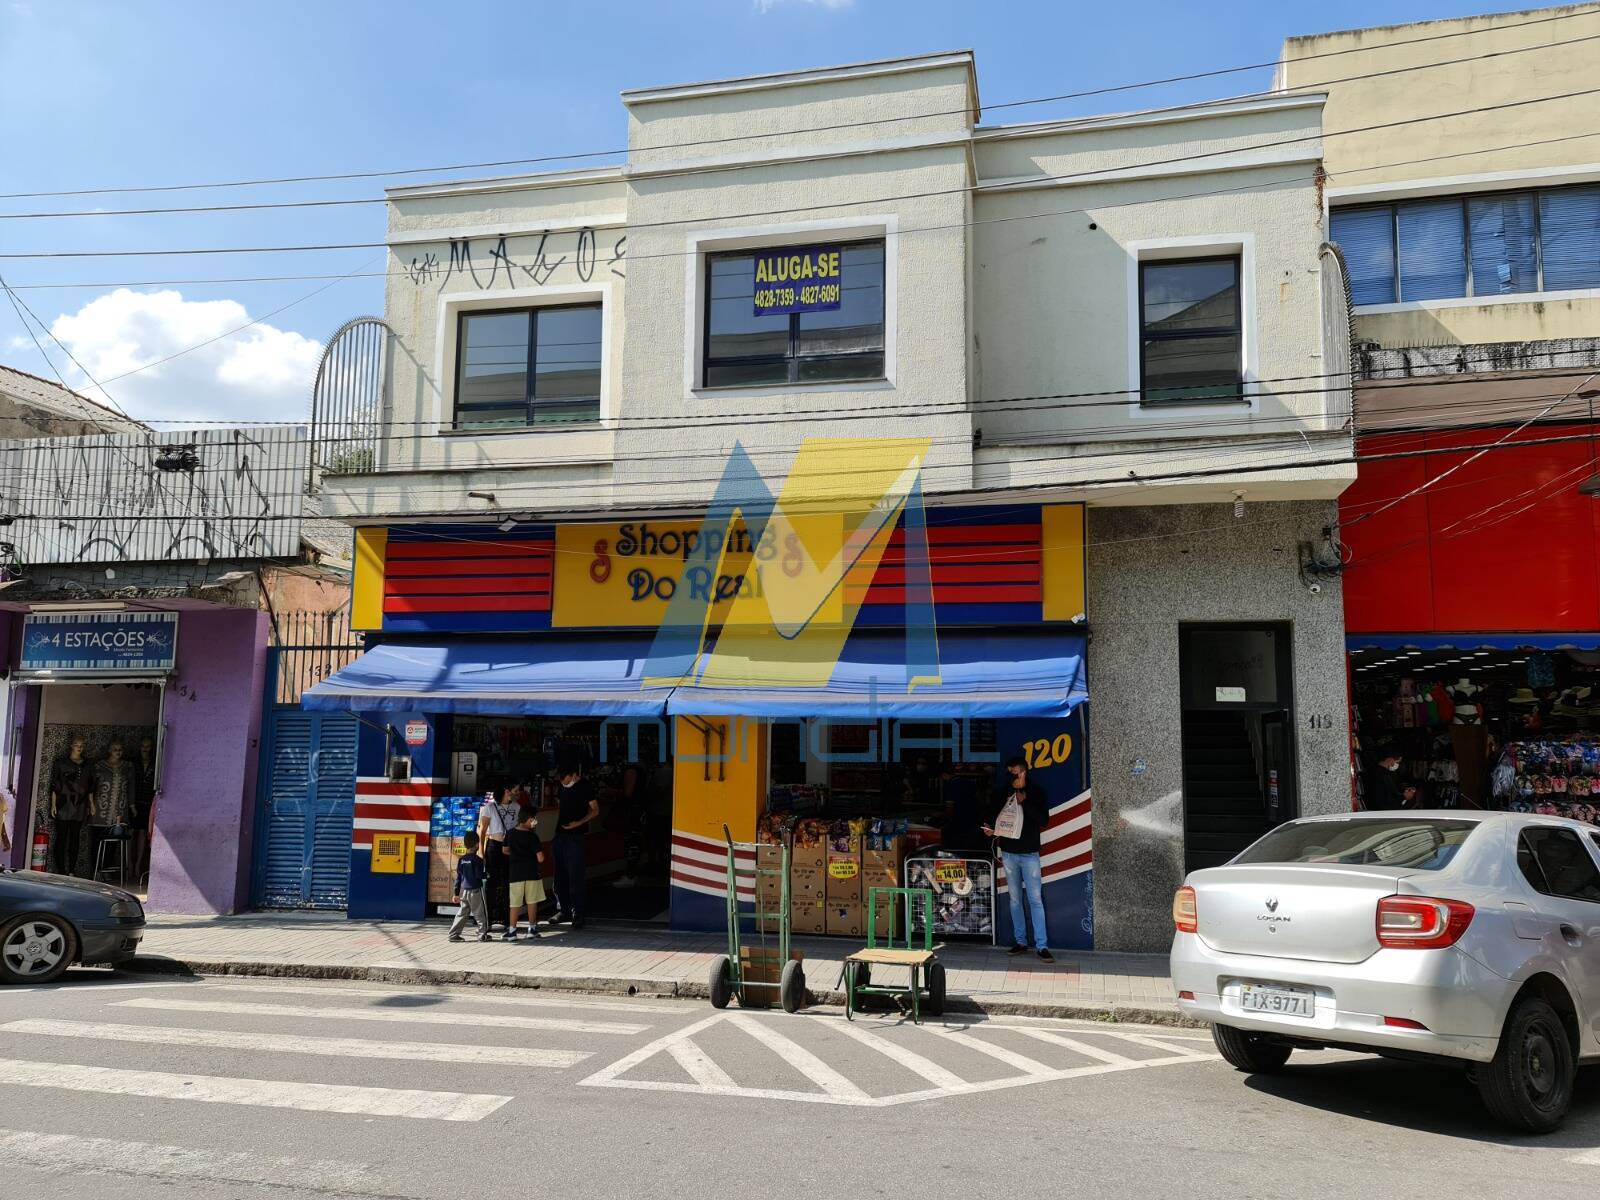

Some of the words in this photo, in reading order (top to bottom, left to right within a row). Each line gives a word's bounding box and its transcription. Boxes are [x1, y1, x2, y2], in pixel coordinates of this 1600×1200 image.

[756, 252, 840, 283] ALUGA-SE
[755, 287, 795, 307] 4828-7359
[801, 283, 840, 305] 4827-6091
[616, 523, 777, 563] Shopping
[627, 567, 676, 601] Do
[51, 634, 61, 647] 4
[64, 629, 145, 651] ESTAÇÕES
[1023, 734, 1072, 769] 120
